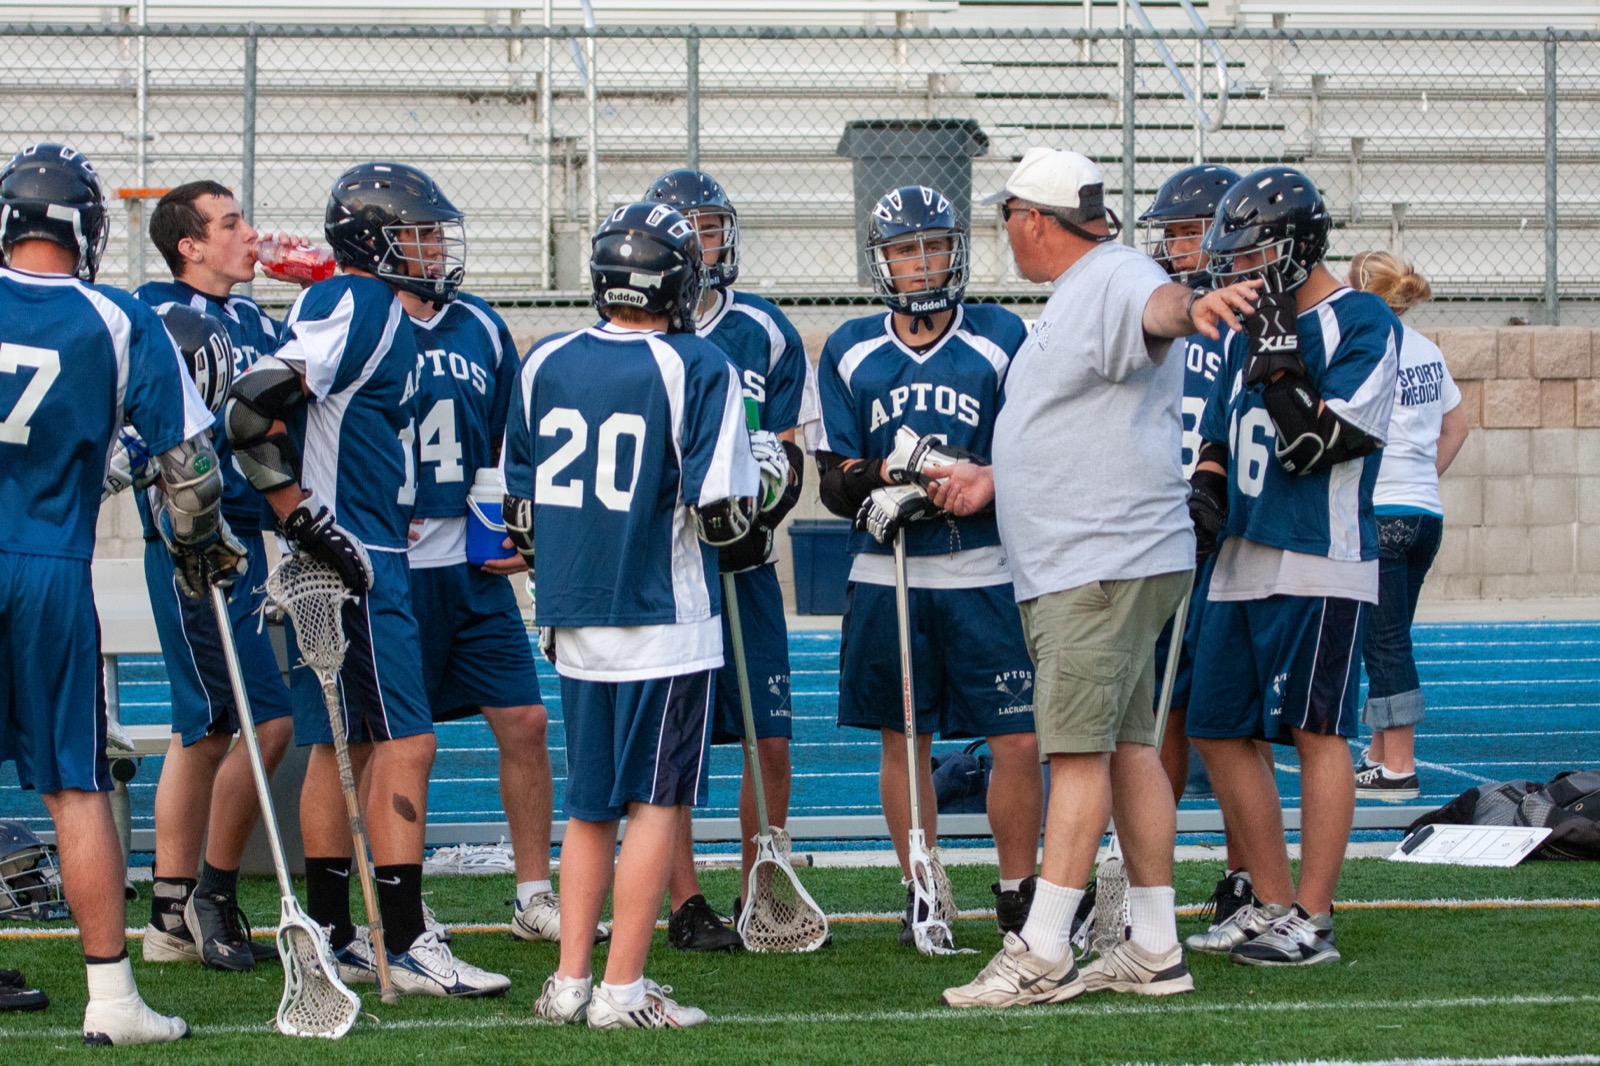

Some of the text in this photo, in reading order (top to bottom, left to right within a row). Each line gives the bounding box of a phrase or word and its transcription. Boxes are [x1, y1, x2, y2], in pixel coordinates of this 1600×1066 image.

[608, 291, 644, 305] Riddell
[911, 298, 948, 312] Riddell
[1257, 334, 1298, 353] STX
[415, 348, 487, 395] PTOS
[1397, 361, 1444, 388] SPORTS
[0, 342, 62, 445] 7
[1400, 380, 1443, 407] MEDICI
[869, 382, 981, 433] APTOS
[418, 398, 465, 484] 4
[534, 406, 647, 512] 20
[768, 674, 791, 685] APT
[995, 670, 1032, 684] APTOS
